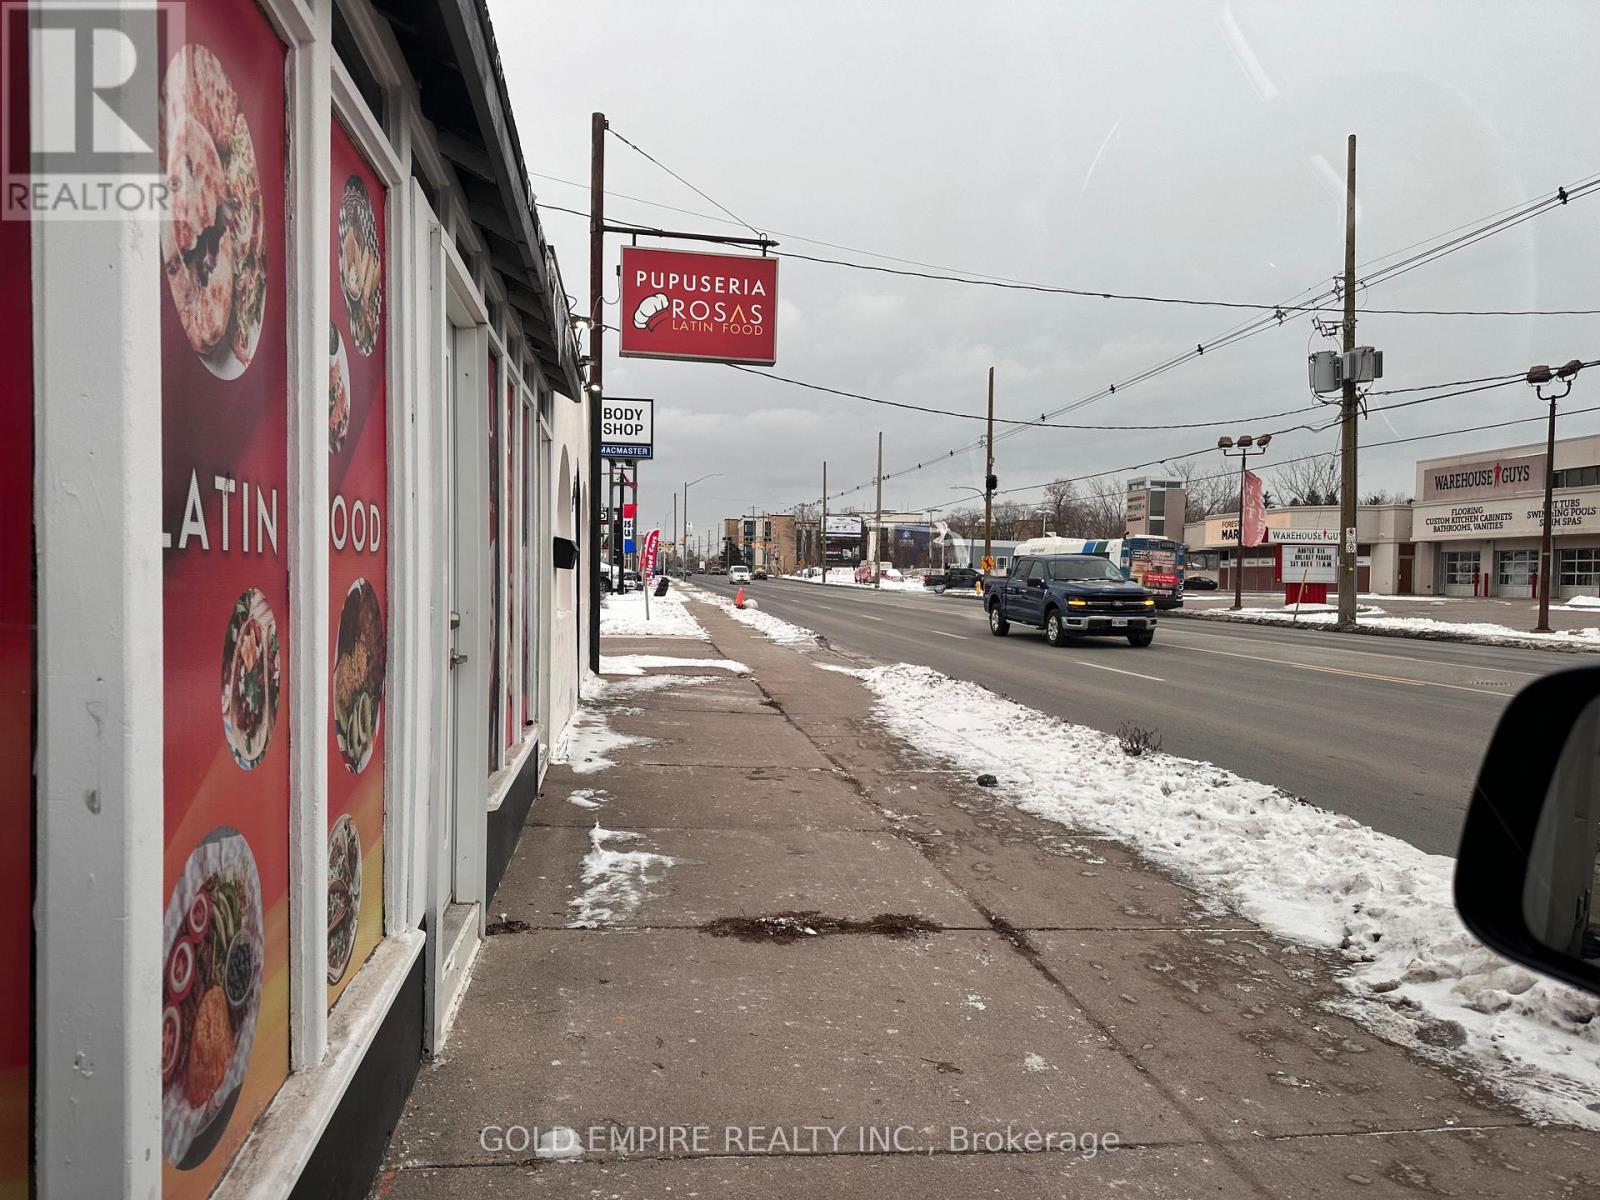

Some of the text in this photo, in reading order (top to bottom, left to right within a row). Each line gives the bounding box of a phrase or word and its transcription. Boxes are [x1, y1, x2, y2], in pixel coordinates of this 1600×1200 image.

[636, 270, 766, 296] PUPUSERIA
[672, 298, 763, 325] ROSAS
[672, 320, 763, 336] LATIN FOOD
[603, 407, 643, 421] BODY
[603, 423, 644, 436] SHOP
[1434, 465, 1530, 491] WAREHOUSE GUYS
[1560, 498, 1580, 508] TUBS
[162, 467, 381, 555] ATIN OOD
[1451, 506, 1483, 516] FLOORING
[1526, 507, 1597, 519] SWIING POOLS
[1425, 512, 1513, 526] CUSTOM KITCHEN CABINETS
[1539, 516, 1582, 527] SIM SPAS
[1433, 521, 1504, 533] BATHROOMS, VANITIES
[1222, 529, 1239, 540] MAR
[1273, 531, 1340, 540] WAREHOUSE GU
